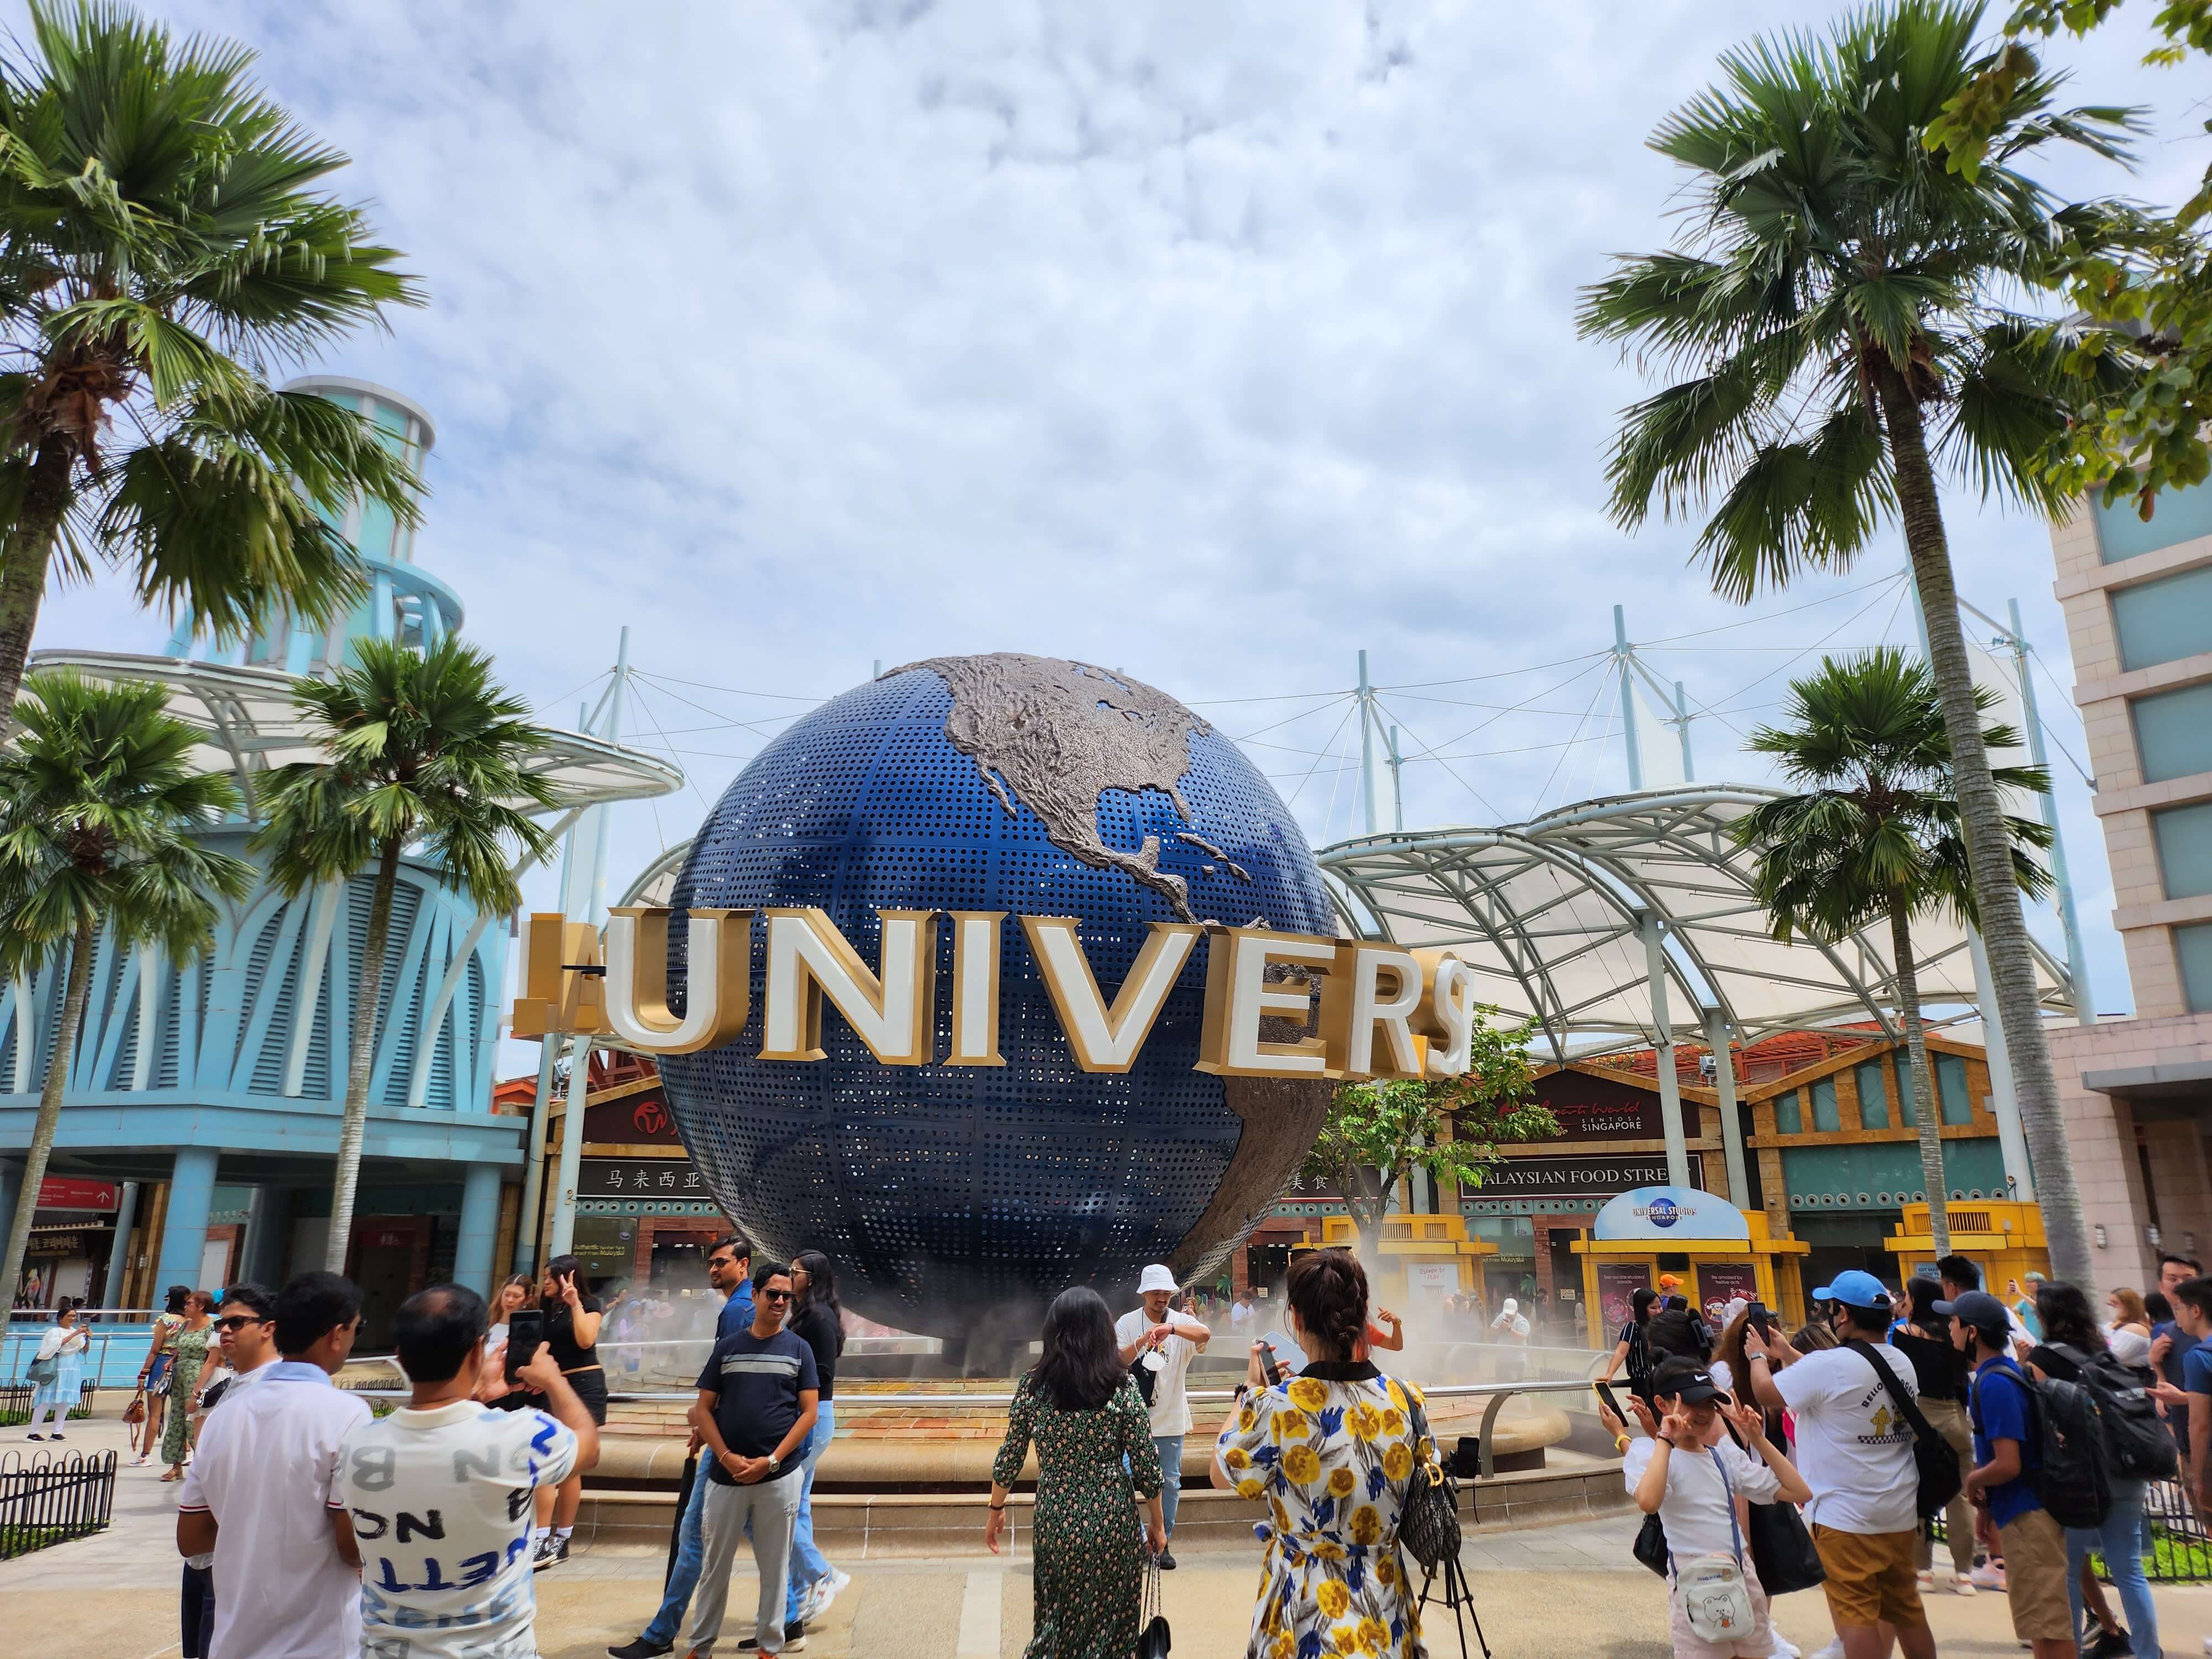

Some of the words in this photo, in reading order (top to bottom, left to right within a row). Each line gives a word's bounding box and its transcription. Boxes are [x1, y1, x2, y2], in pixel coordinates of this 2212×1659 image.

[1592, 1102, 1640, 1115] World
[1581, 1121, 1642, 1132] SINGAPORE
[1479, 1171, 1566, 1186] ALAYSIAN
[1570, 1168, 1620, 1183] FOOD
[1623, 1167, 1691, 1182] STRE
[1633, 1207, 1667, 1216] UNIVERSAL
[1668, 1207, 1697, 1216] STUDIOS
[1861, 1383, 1884, 1408] BELLO
